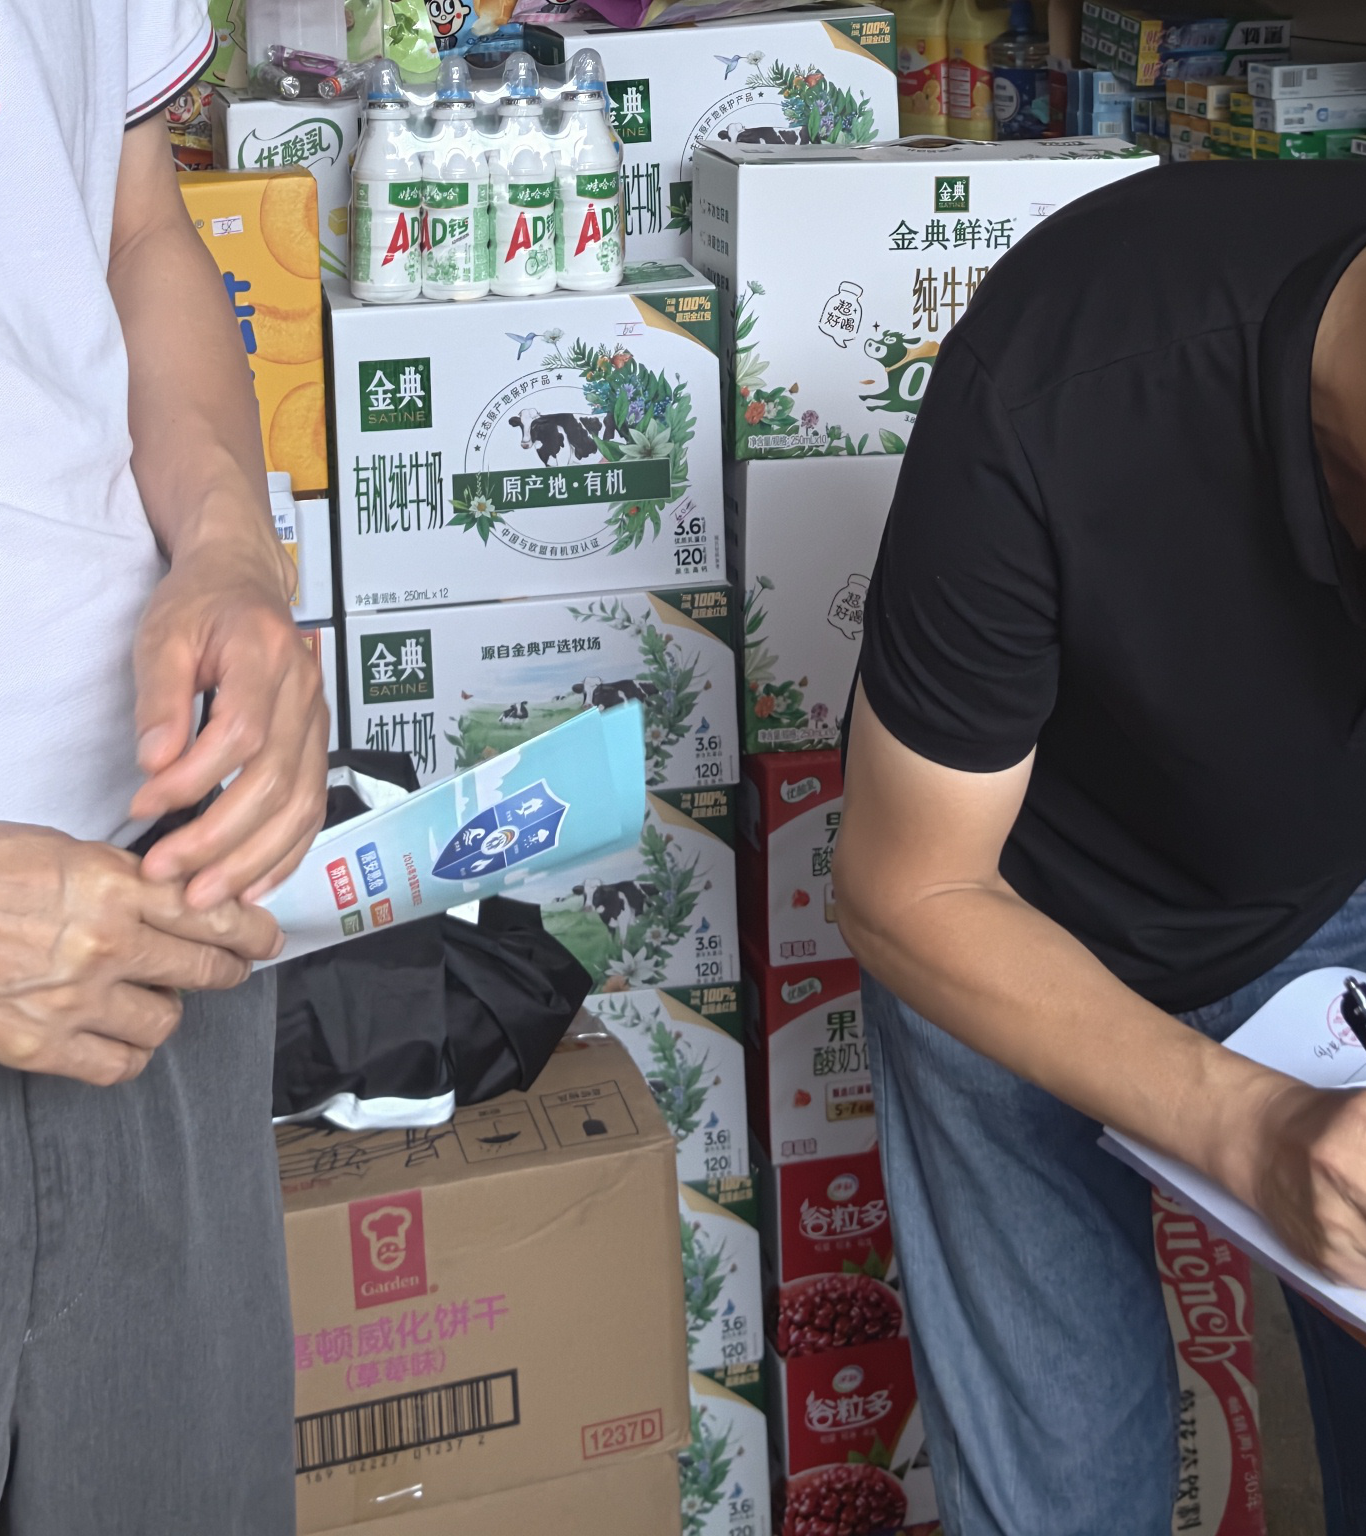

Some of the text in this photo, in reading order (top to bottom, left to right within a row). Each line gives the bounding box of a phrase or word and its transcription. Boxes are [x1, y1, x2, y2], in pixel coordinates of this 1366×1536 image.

[862, 21, 890, 35] 100%
[256, 124, 332, 166] 优酸乳
[938, 180, 966, 203] 金典
[888, 218, 1013, 251] 金典鲜活
[678, 295, 711, 312] 100%
[833, 298, 854, 316] 超
[825, 312, 856, 335] 好喝
[366, 366, 426, 411] 金典
[476, 373, 552, 441] 生态原产地保护产品
[368, 410, 426, 424] SATINE
[353, 451, 443, 535] 有机纯牛奶
[502, 468, 627, 503] 原产地·有机
[674, 517, 701, 536] 3.6
[501, 527, 601, 556] 中国与欧盟有机双认证
[674, 548, 703, 566] 120
[694, 591, 727, 607] 100%
[481, 636, 601, 661] 源自金典严选牧场
[367, 638, 426, 684] 金典
[369, 682, 428, 697] SATINE
[695, 735, 718, 752] 3.6
[695, 763, 719, 779] 120
[694, 790, 727, 807] 100%
[695, 935, 718, 951] 3.6
[695, 962, 719, 978] 120
[703, 987, 736, 1006] 100%
[704, 1130, 727, 1146] 3.6
[704, 1155, 729, 1171] 120
[800, 1198, 887, 1237] 谷粒多
[361, 1272, 420, 1297] Garden
[721, 1318, 744, 1332] 3.6
[721, 1340, 745, 1358] 120
[806, 1390, 893, 1429] 谷粒多
[587, 1416, 658, 1453] 1237D
[412, 1438, 466, 1463] 01237
[728, 1497, 752, 1515] 3.6
